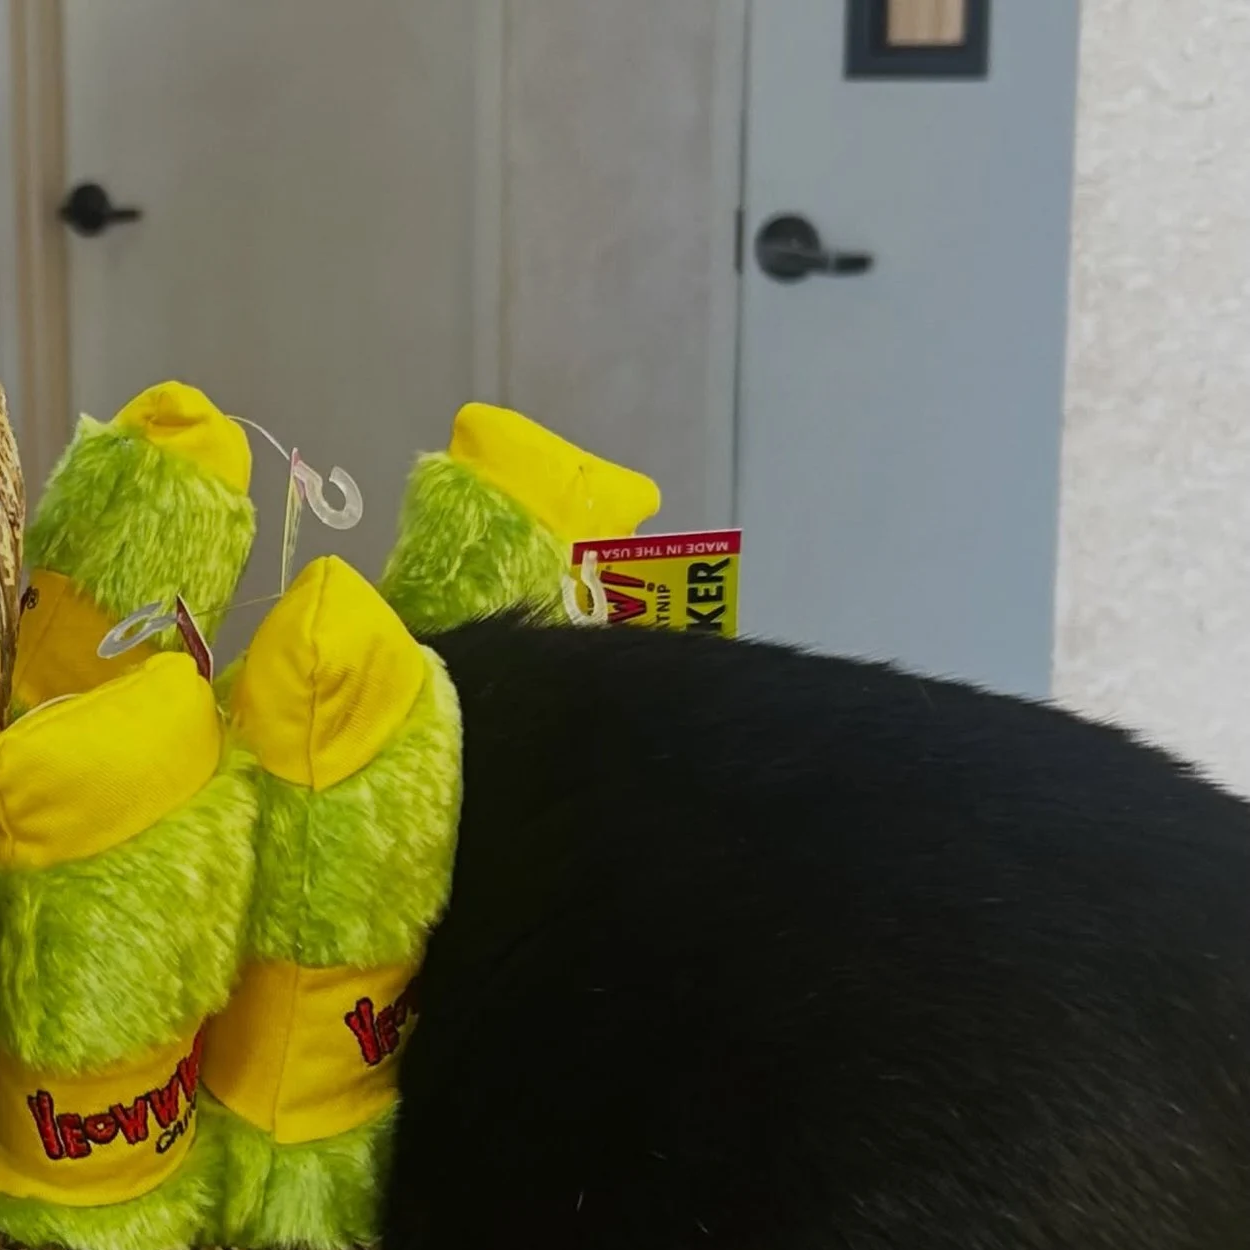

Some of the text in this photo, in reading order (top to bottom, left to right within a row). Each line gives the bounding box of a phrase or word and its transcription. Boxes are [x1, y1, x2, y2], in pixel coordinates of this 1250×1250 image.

[601, 541, 728, 559] MADE IN THE USA
